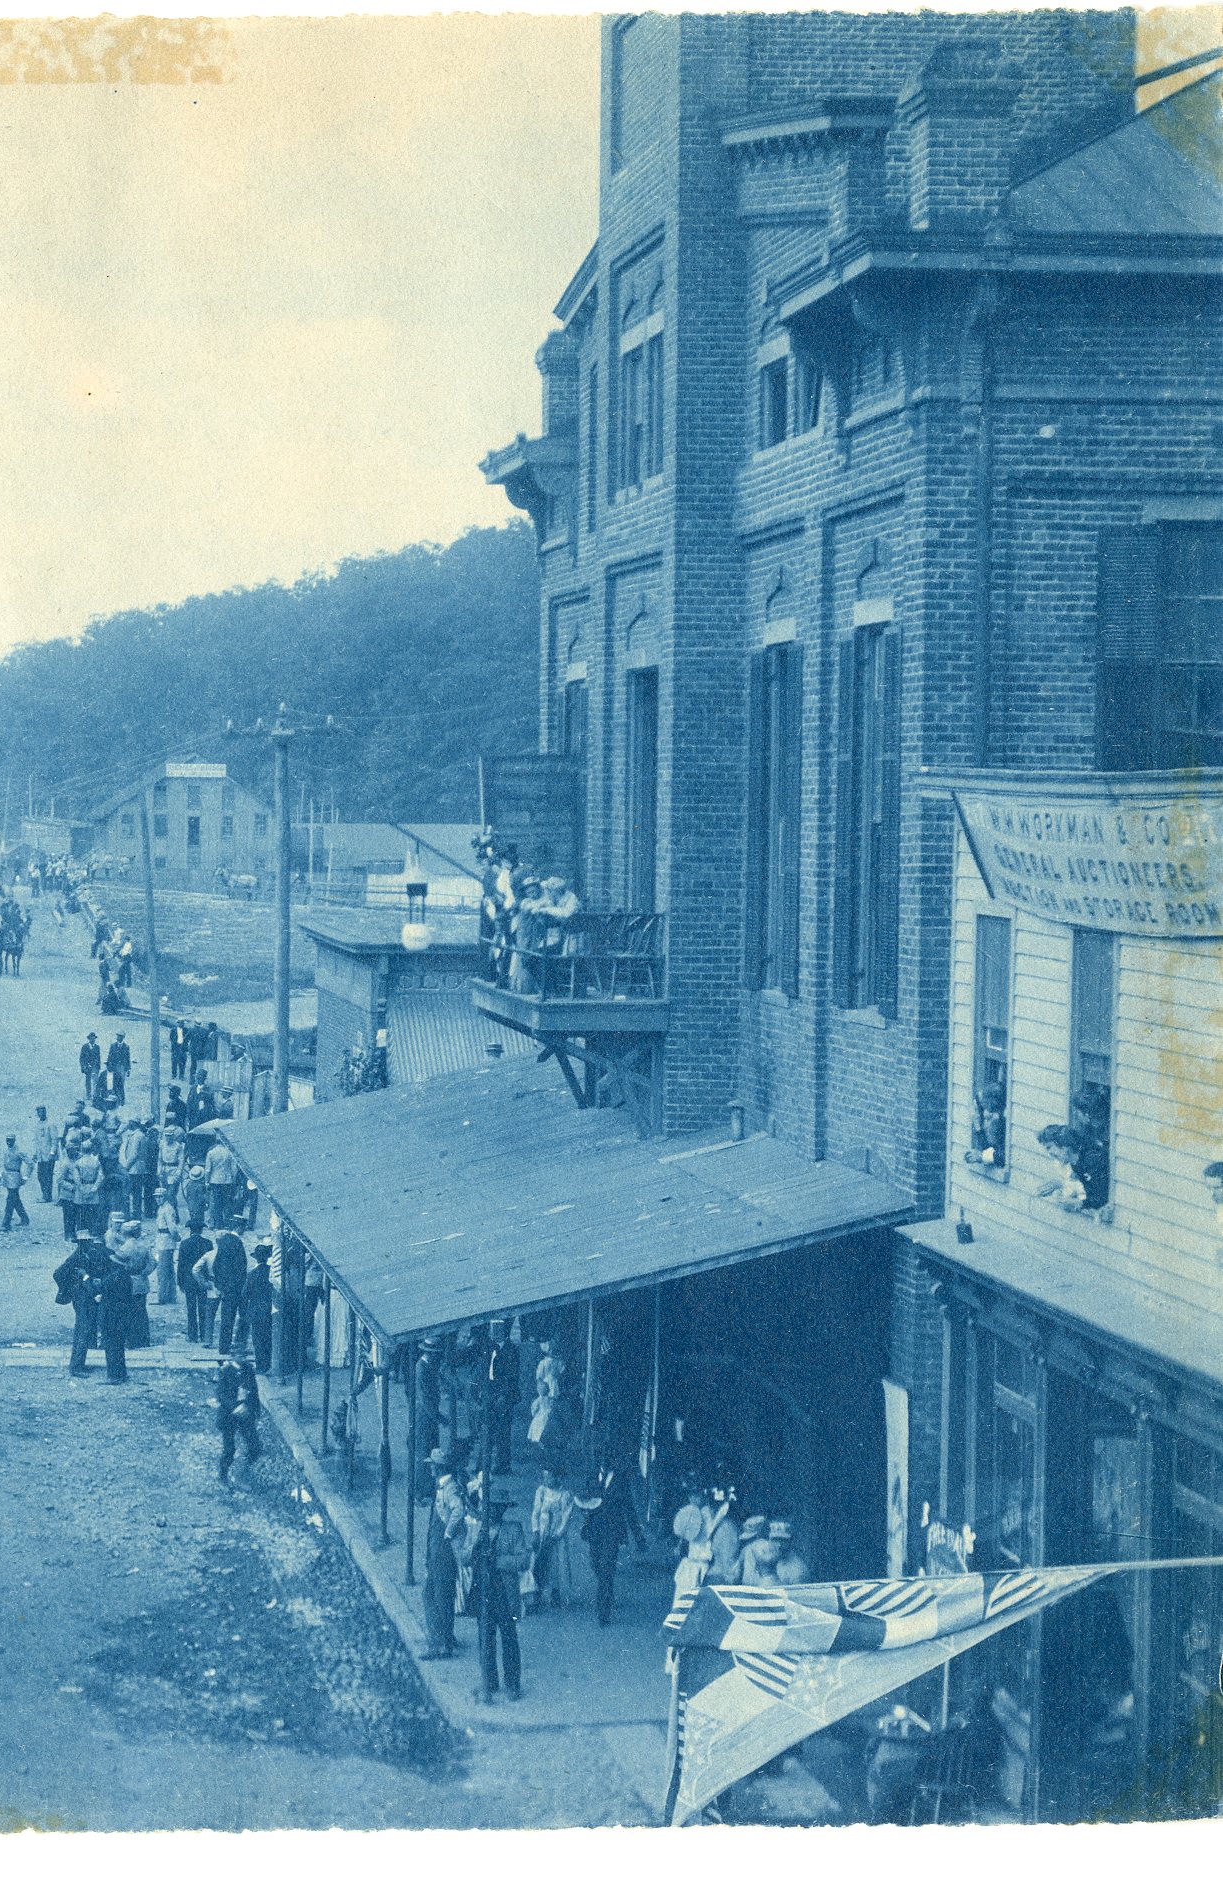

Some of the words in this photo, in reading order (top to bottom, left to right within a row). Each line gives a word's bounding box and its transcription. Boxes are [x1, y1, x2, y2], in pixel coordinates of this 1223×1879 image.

[1117, 815, 1129, 845] &
[994, 844, 1063, 884] GENERAL
[1067, 856, 1194, 893] AUCTIONEERS
[1083, 897, 1158, 924] STORAGE
